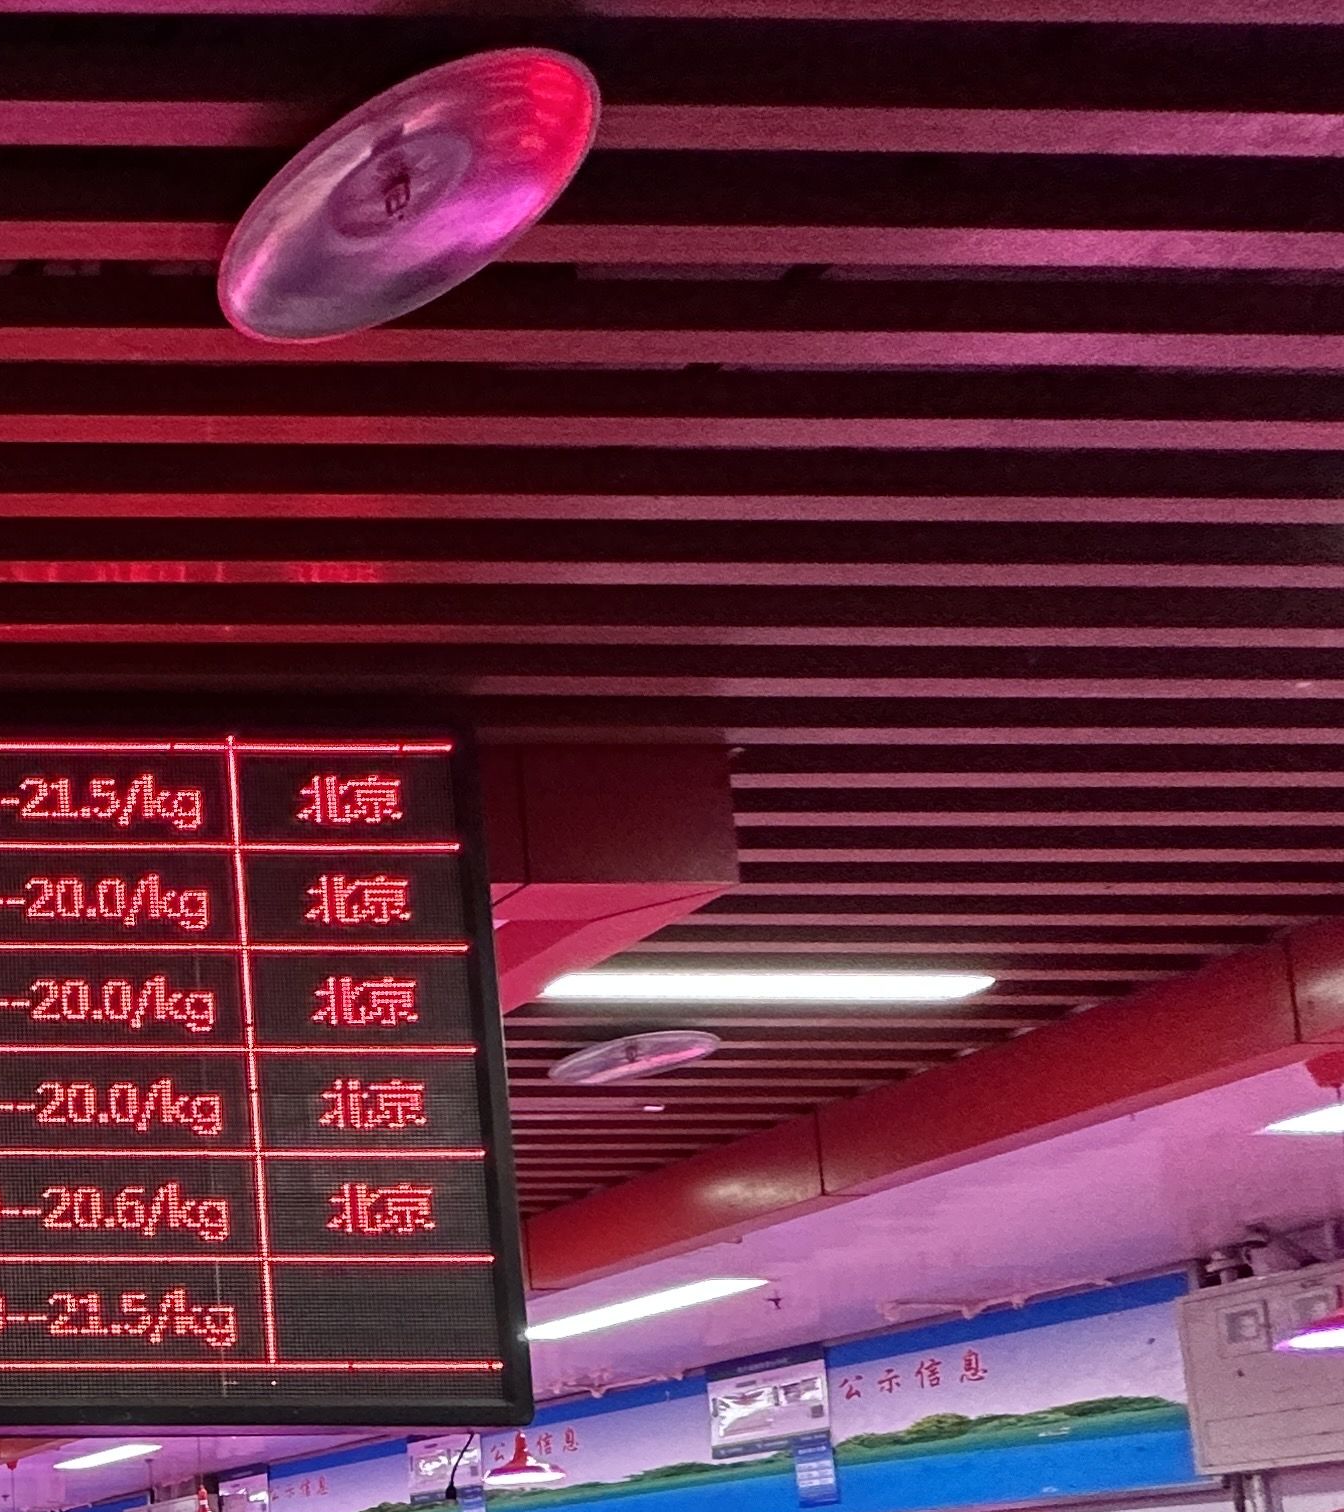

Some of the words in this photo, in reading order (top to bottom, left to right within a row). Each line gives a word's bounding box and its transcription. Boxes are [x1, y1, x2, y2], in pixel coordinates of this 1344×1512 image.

[297, 773, 401, 827] 北京
[307, 872, 410, 928] 北京
[311, 975, 417, 1028] 北京
[319, 1078, 425, 1131] 北京
[328, 1183, 433, 1237] 北京
[838, 1350, 988, 1400] 公示信息
[490, 1427, 579, 1462] 公信息
